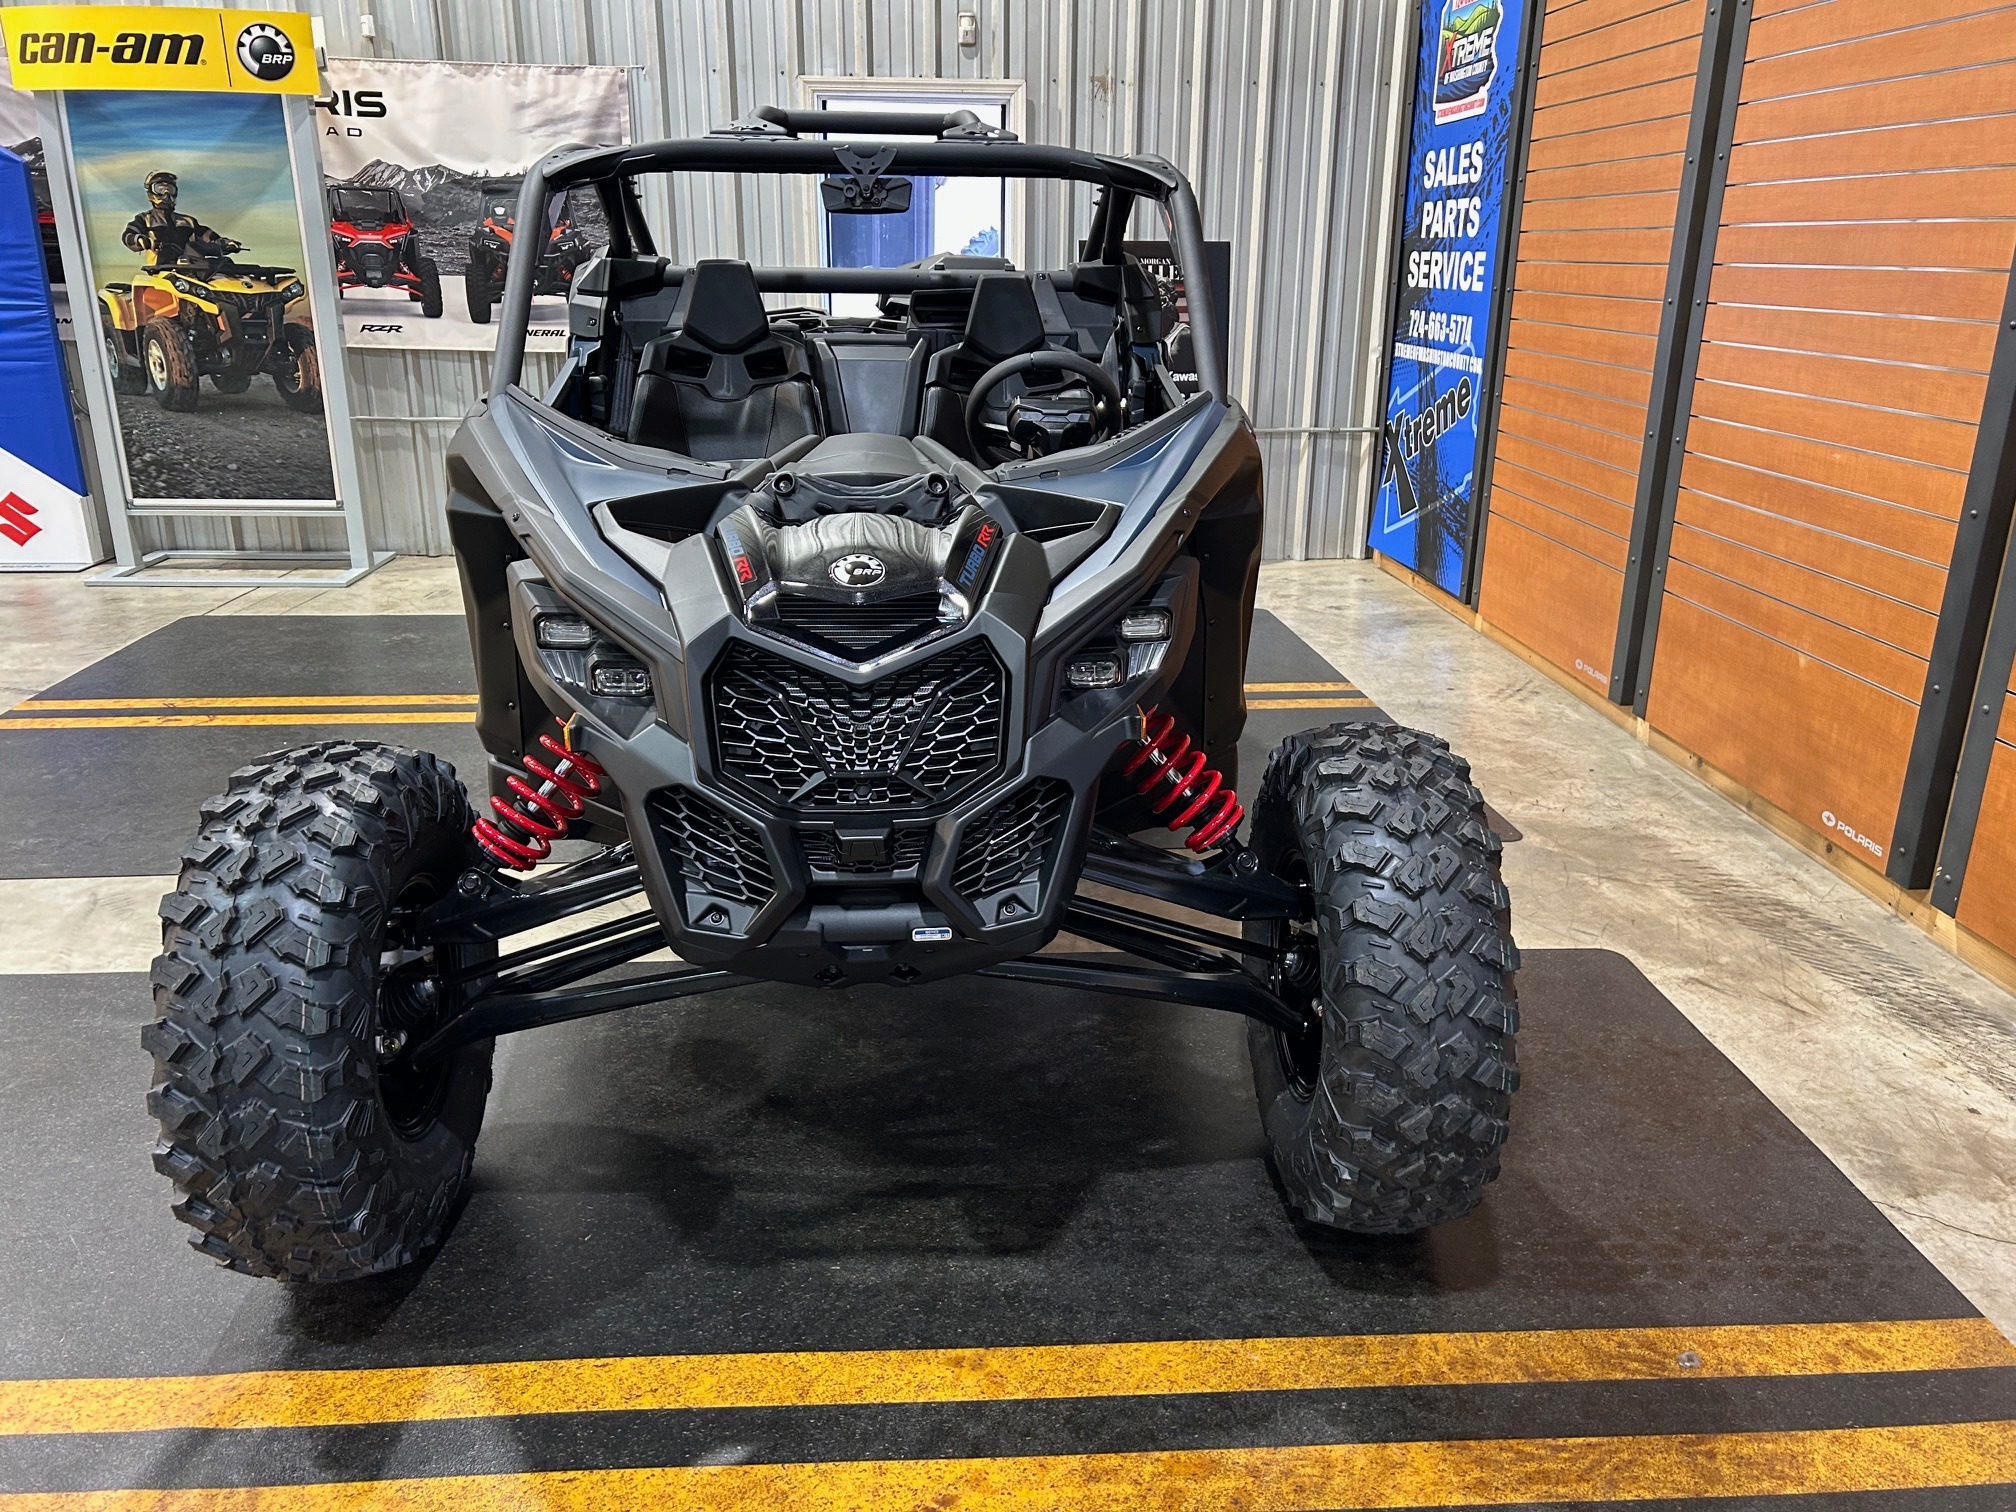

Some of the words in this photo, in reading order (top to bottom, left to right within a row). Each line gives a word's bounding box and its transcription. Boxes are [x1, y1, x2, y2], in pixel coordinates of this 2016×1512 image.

[20, 32, 205, 66] can-am
[261, 53, 293, 65] BRP
[1439, 27, 1494, 77] XTREME
[1423, 140, 1484, 189] SALES
[1421, 196, 1482, 239] PARTS
[1140, 257, 1171, 265] MORGAN
[1407, 250, 1487, 292] SERVICE
[360, 324, 403, 334] RZR
[1408, 309, 1473, 347] 724-663-5774
[1382, 375, 1472, 519] Xtreme
[733, 556, 753, 583] RR
[852, 567, 882, 577] BRP
[959, 543, 985, 587] TURBO
[977, 524, 995, 548] RR
[1837, 820, 1883, 857] POLARIS
